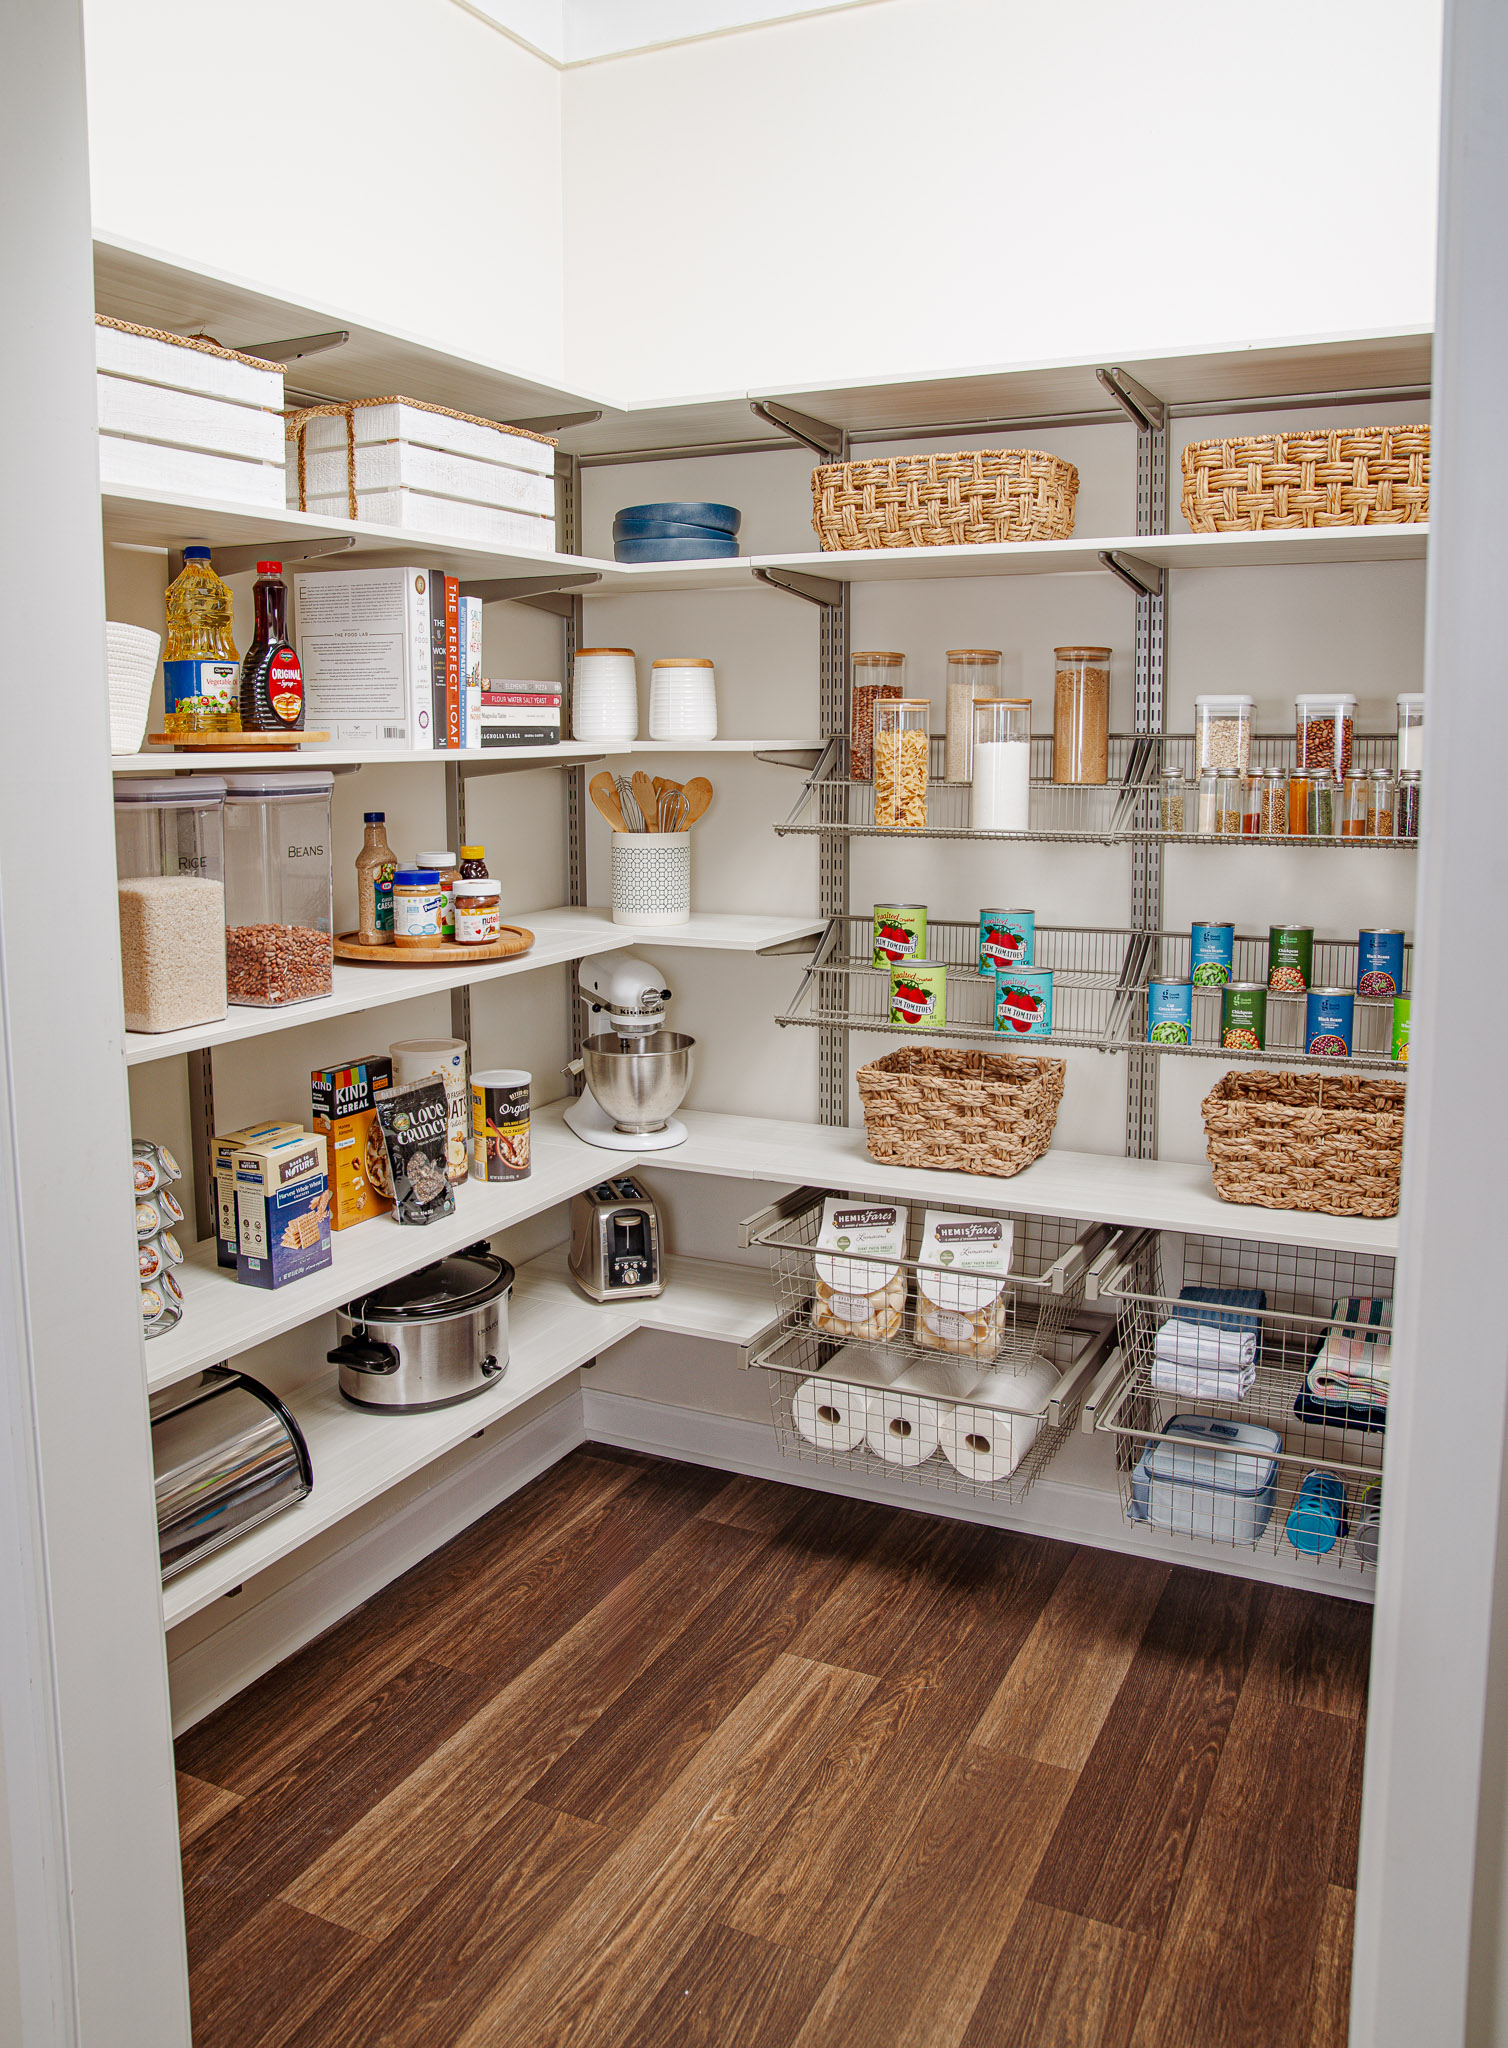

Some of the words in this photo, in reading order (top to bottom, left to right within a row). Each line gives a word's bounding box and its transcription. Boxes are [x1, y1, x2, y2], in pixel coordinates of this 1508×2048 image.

[449, 585, 457, 613] THE
[434, 619, 445, 627] THE
[449, 626, 458, 692] PERFECT
[271, 668, 301, 680] ORIGINAL
[206, 679, 232, 687] Vegetable
[281, 680, 294, 688] Syrup
[491, 695, 507, 703] FLOUR
[507, 696, 522, 704] WATER
[534, 697, 547, 705] YEAST
[450, 704, 459, 743] LOAF
[288, 846, 324, 858] BEANS
[178, 856, 207, 870] RICE
[377, 902, 393, 910] CAESA
[886, 941, 914, 953] TOMATOES
[982, 943, 994, 953] PLUM
[994, 946, 1023, 959] TOMATOES
[903, 1001, 932, 1014] TOMATOES
[999, 1004, 1011, 1015] PLUM
[1013, 1007, 1042, 1021] TOMATOES
[312, 1081, 332, 1091] KIND
[336, 1082, 368, 1105] KIND
[336, 1099, 369, 1115] CEREAL
[285, 1157, 315, 1178] NATURE
[278, 1190, 296, 1200] Harvest
[296, 1185, 309, 1194] Whole
[309, 1180, 322, 1188] Wheat
